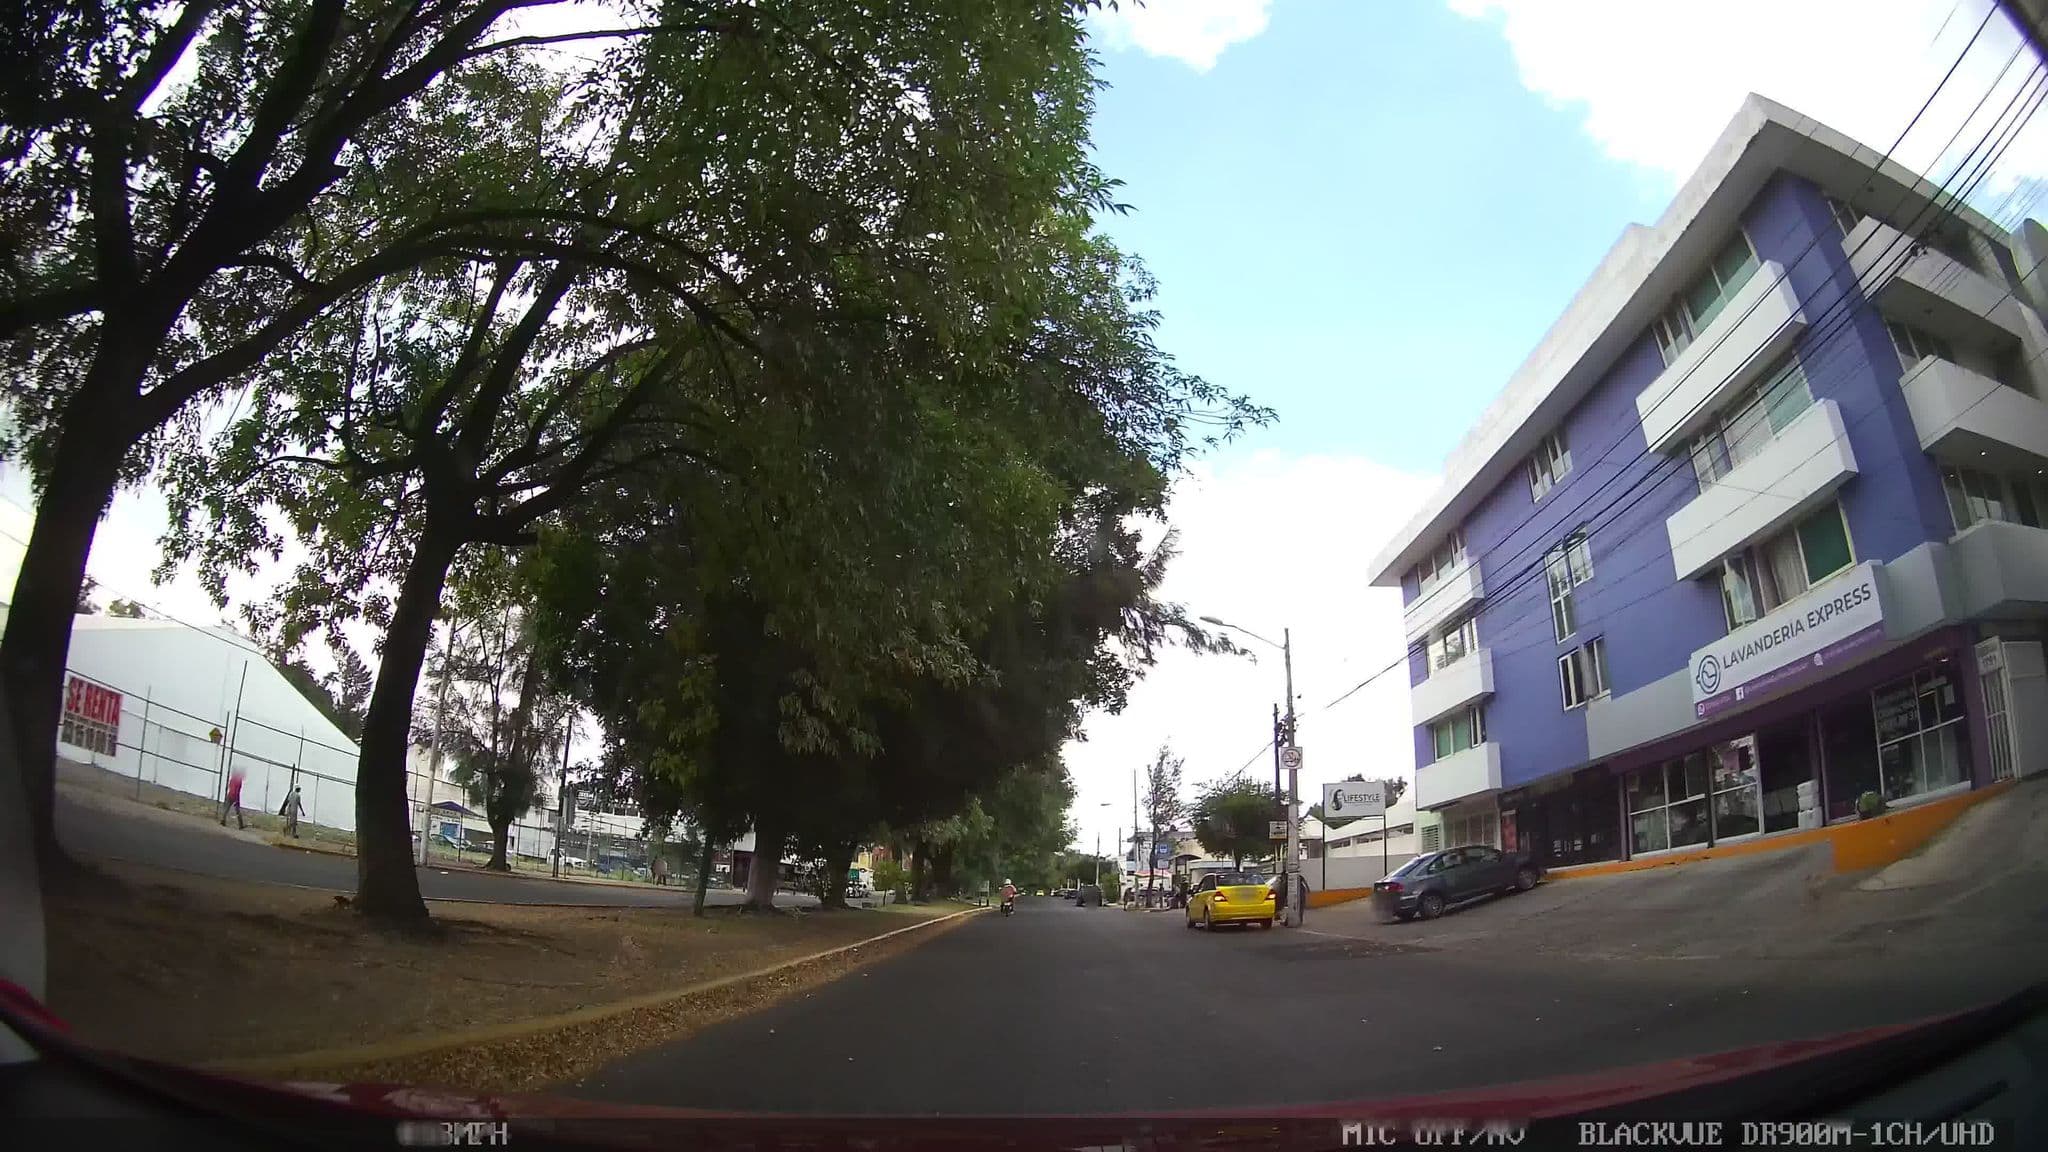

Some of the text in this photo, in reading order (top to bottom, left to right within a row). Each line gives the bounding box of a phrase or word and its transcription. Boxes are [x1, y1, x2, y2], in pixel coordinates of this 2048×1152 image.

[1723, 619, 1804, 669] LAVANDERIA
[1806, 583, 1871, 629] EXPRESS
[69, 677, 122, 725] SE RENTA
[1344, 793, 1380, 802] LIFESTYLE
